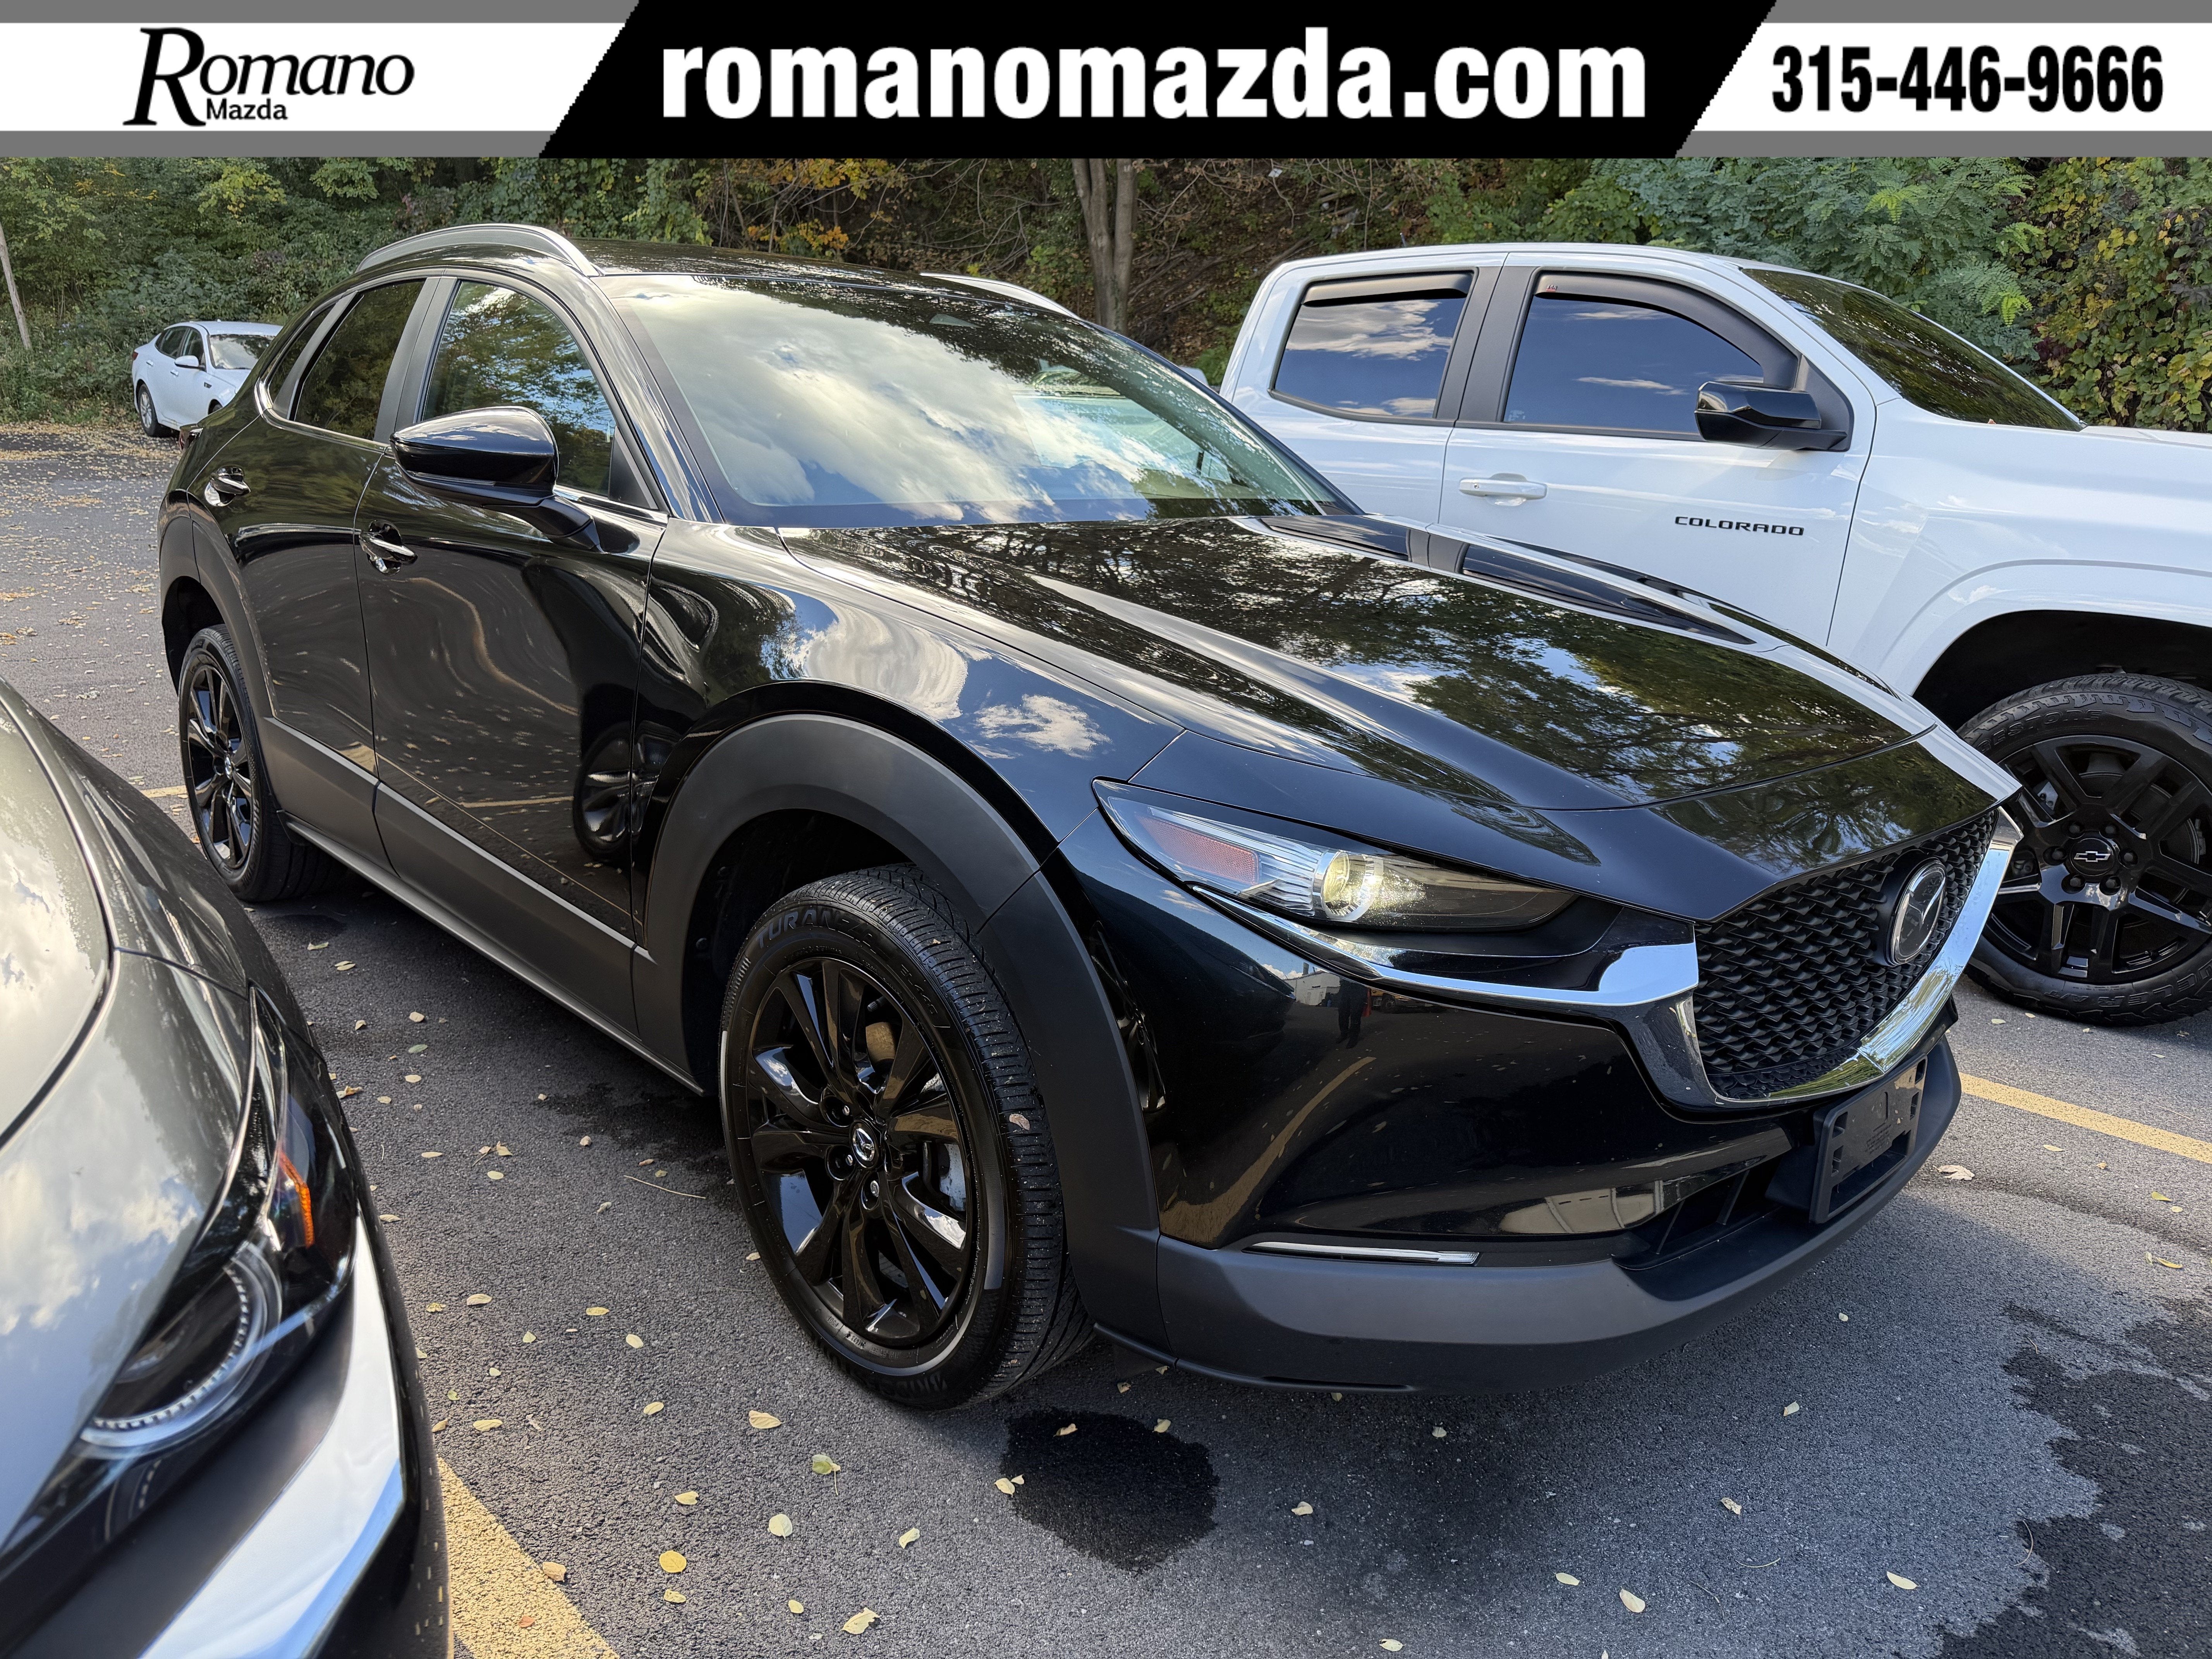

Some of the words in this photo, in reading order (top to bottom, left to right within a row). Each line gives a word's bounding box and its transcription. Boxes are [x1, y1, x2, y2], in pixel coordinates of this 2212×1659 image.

[1674, 516, 1805, 536] COLORADO
[1976, 709, 2104, 754] GESTONE
[2098, 958, 2212, 1007] UELER
